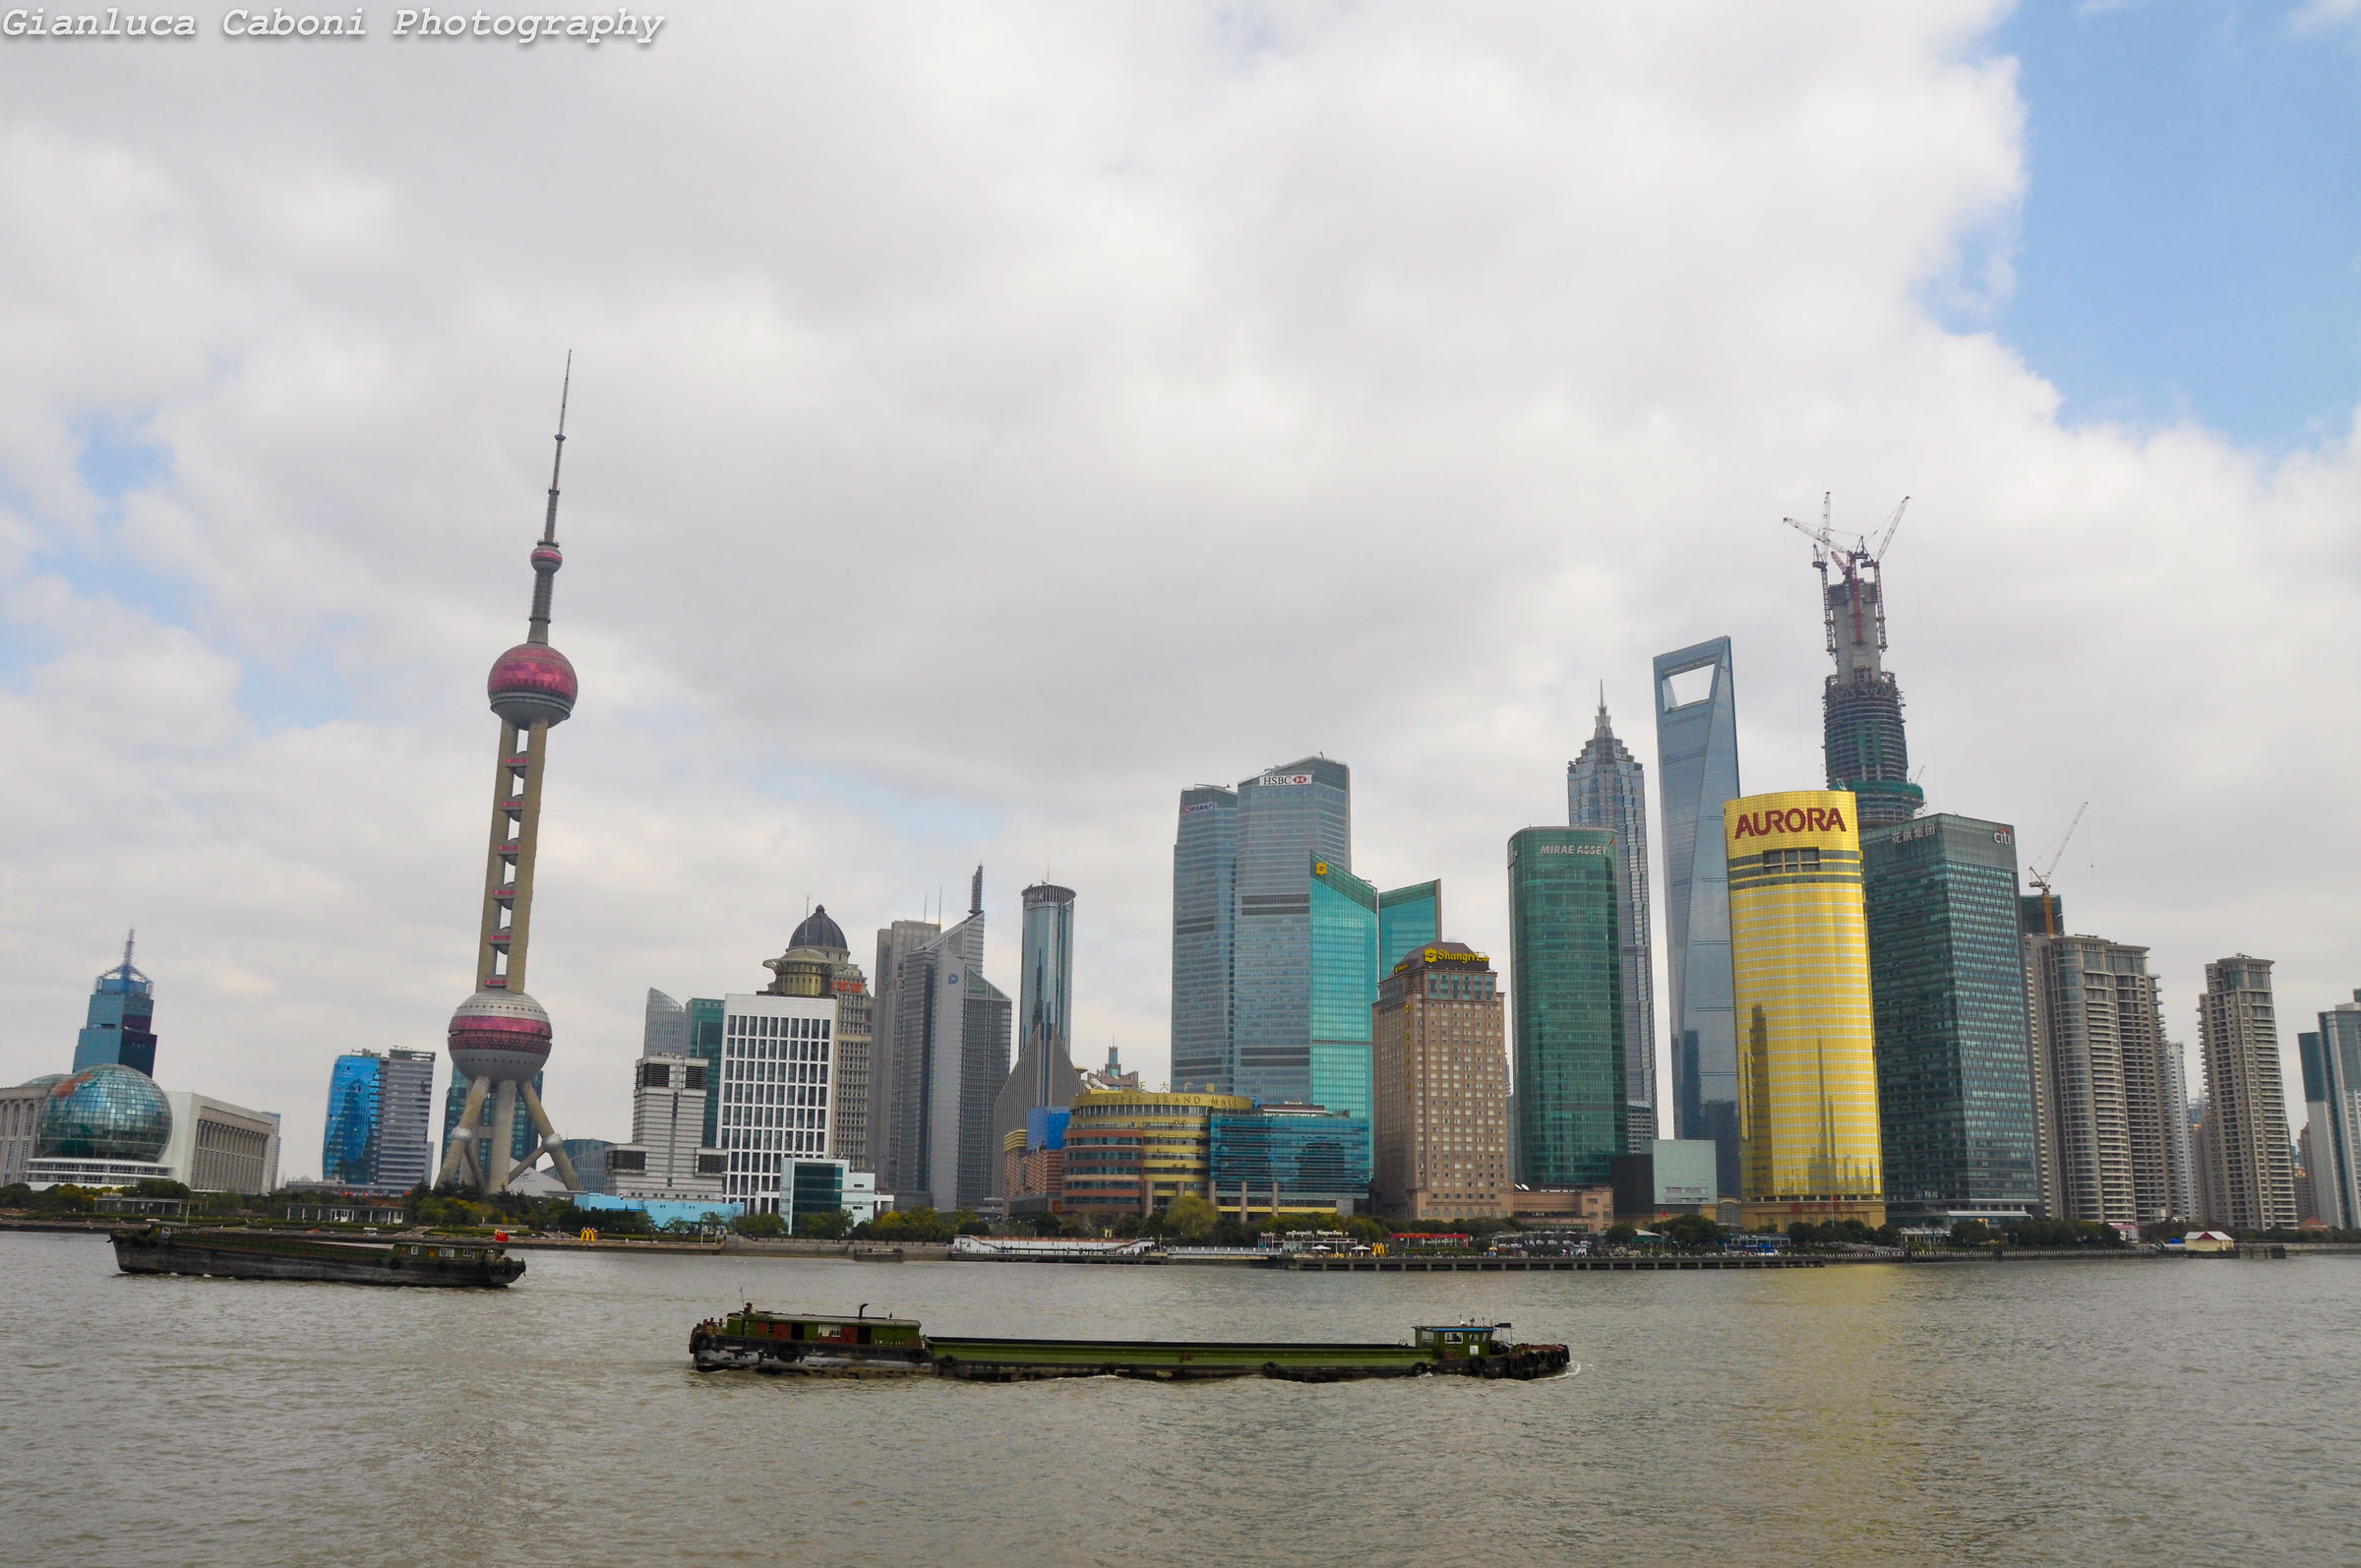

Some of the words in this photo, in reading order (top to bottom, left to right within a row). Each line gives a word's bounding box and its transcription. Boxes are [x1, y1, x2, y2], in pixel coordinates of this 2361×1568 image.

[1263, 775, 1292, 786] HSBC
[1734, 808, 1846, 840] AURORA
[1993, 829, 2011, 845] citi
[1540, 845, 1574, 855] MIRAE
[1576, 845, 1607, 855] ASSET
